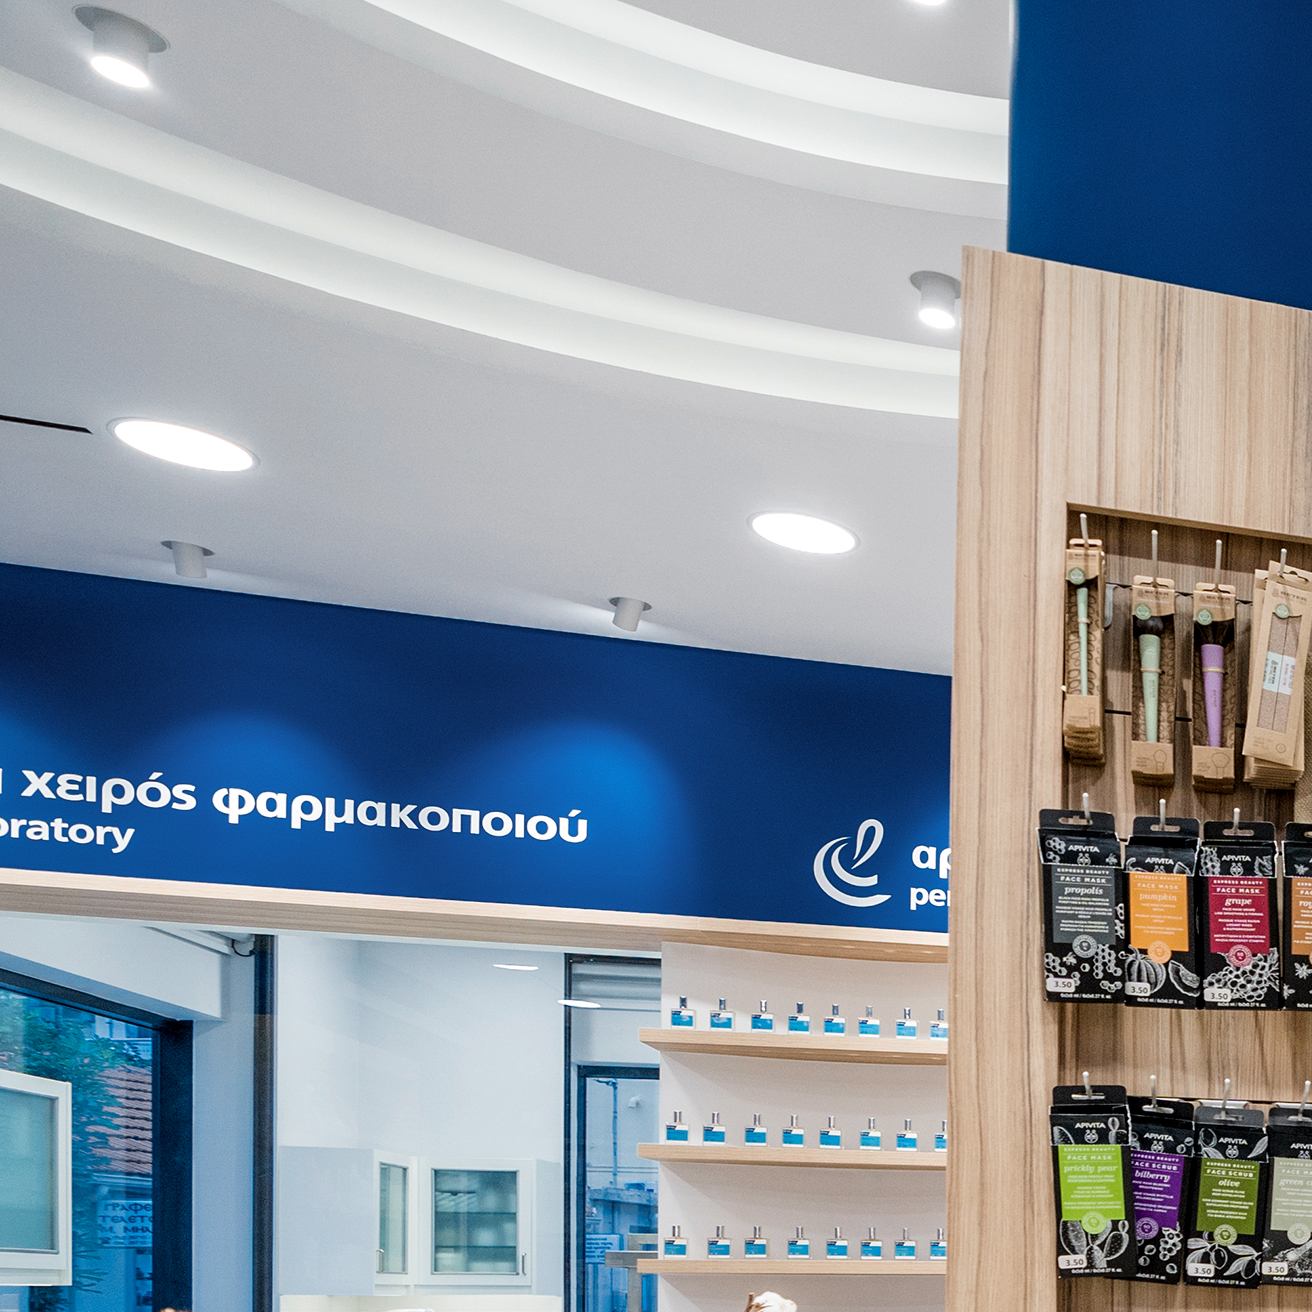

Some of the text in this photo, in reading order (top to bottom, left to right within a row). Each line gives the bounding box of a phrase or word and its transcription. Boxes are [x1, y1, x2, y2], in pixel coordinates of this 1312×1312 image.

[21, 770, 588, 844] χειρός φαρμακοποιού
[1068, 845, 1100, 853] APIVITA
[1145, 857, 1174, 866] APIVITA
[1221, 855, 1251, 863] APIVITA
[1083, 876, 1106, 884] MASK
[1064, 886, 1103, 895] propolis
[910, 887, 951, 910] pe
[1139, 893, 1176, 902] pumpkin
[1225, 897, 1252, 906] grape
[1054, 981, 1072, 989] 3.50
[1131, 987, 1148, 995] 3.50
[1211, 993, 1228, 1001] 3.50
[1075, 1122, 1106, 1130] APIVITA
[1144, 1133, 1174, 1142] APIVITA
[1219, 1138, 1247, 1146] APIVITA
[1064, 1165, 1118, 1174] prickly pear
[1135, 1170, 1170, 1181] bilberry
[1219, 1179, 1240, 1188] olive
[1279, 1178, 1303, 1187] green
[1066, 1259, 1083, 1267] 3.50
[1194, 1268, 1211, 1276] 3.50
[1268, 1266, 1284, 1274] 3.50
